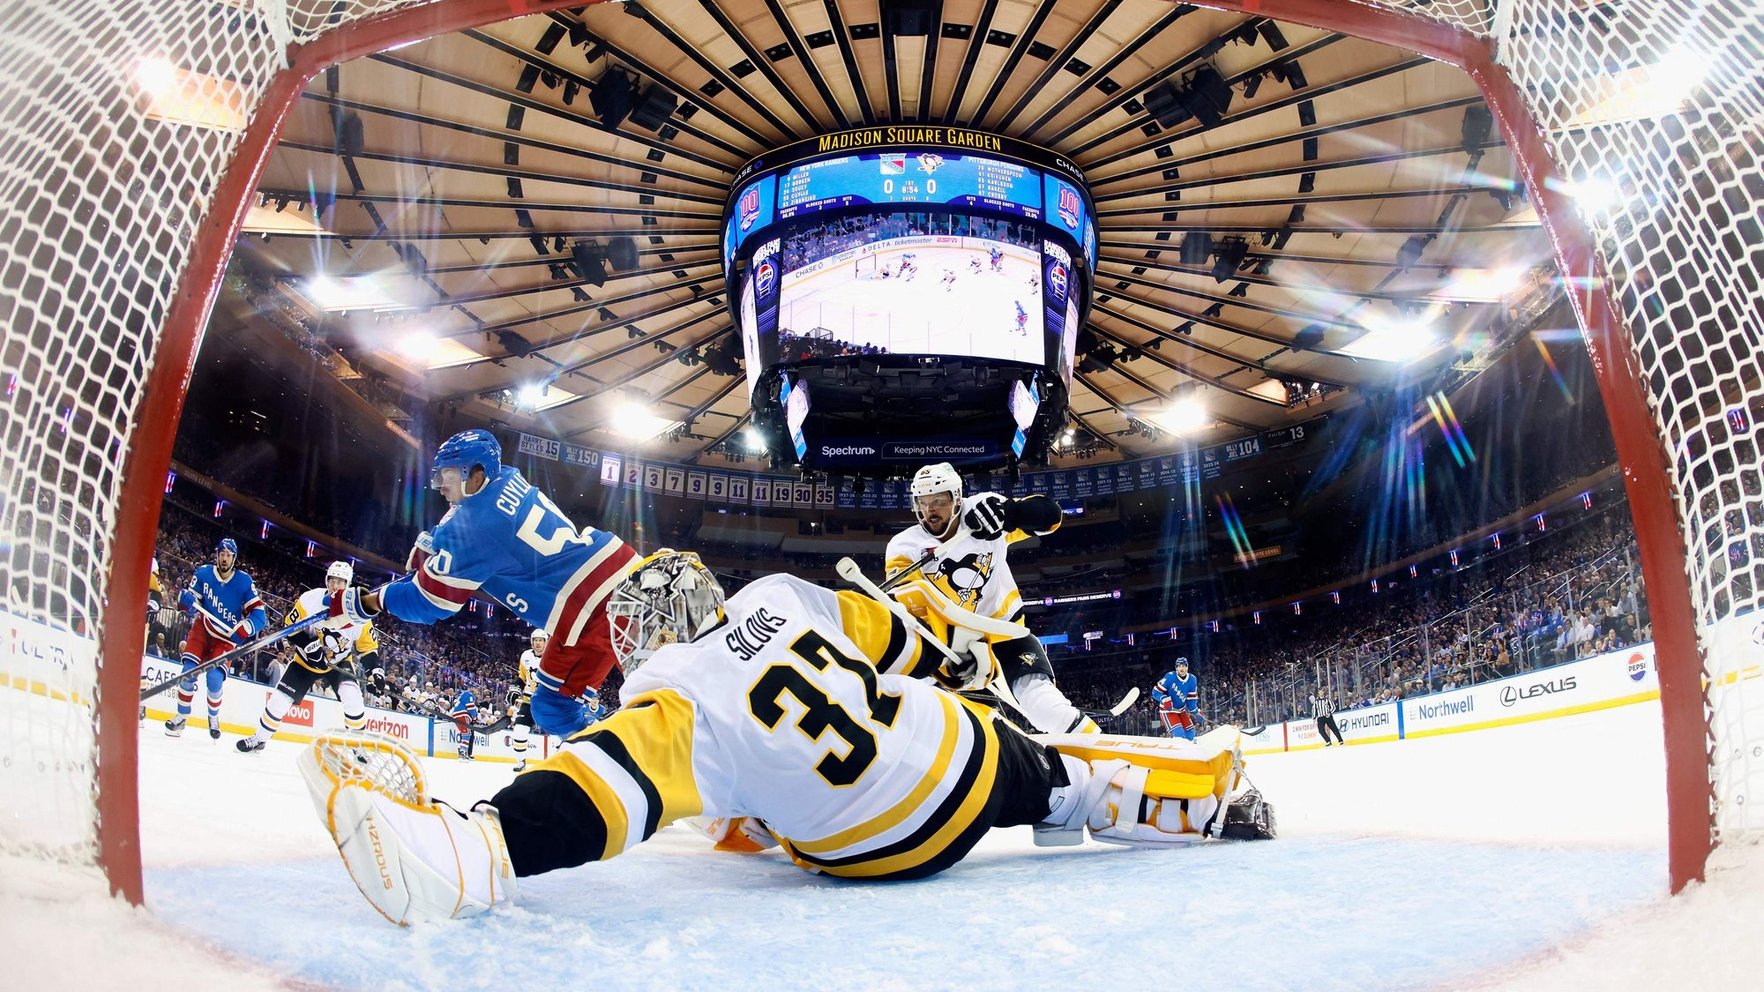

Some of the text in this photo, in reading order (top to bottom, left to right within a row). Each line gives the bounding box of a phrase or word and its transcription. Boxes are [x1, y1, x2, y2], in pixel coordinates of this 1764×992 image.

[819, 127, 1001, 152] MADISON SQUARE GARDEN
[883, 179, 894, 194] 0
[926, 179, 937, 194] 0
[868, 241, 891, 252] DELTA
[894, 237, 932, 246] ticketmaster
[795, 264, 818, 279] CHASE
[1290, 426, 1305, 440] 13
[520, 441, 544, 453] STYLES
[523, 434, 542, 446] HARRY
[545, 440, 558, 456] 15
[822, 446, 872, 458] Spectrum
[894, 446, 985, 455] Keeping NYC Connected
[1239, 439, 1260, 456] 104
[578, 448, 599, 465] 150
[606, 466, 613, 480] 1
[628, 470, 638, 483] 2
[649, 473, 658, 487] 3
[670, 477, 679, 490] 7
[692, 479, 701, 493] 9
[714, 482, 723, 495] 9
[732, 484, 745, 498] 11
[754, 487, 767, 500] 11
[775, 488, 790, 501] 19
[795, 489, 811, 502] 30
[816, 490, 833, 503] 35
[203, 582, 238, 625] RANGERS
[1053, 596, 1077, 604] RANGERS
[1089, 593, 1112, 601] DESERVE
[725, 607, 788, 662] SILOVS
[1628, 663, 1646, 673] PEPSI
[1519, 676, 1577, 700] LEXUS
[746, 628, 903, 789] 37
[1419, 695, 1474, 720] Northwell
[1351, 712, 1390, 730] HYUNDAI
[449, 728, 490, 747] Nowell
